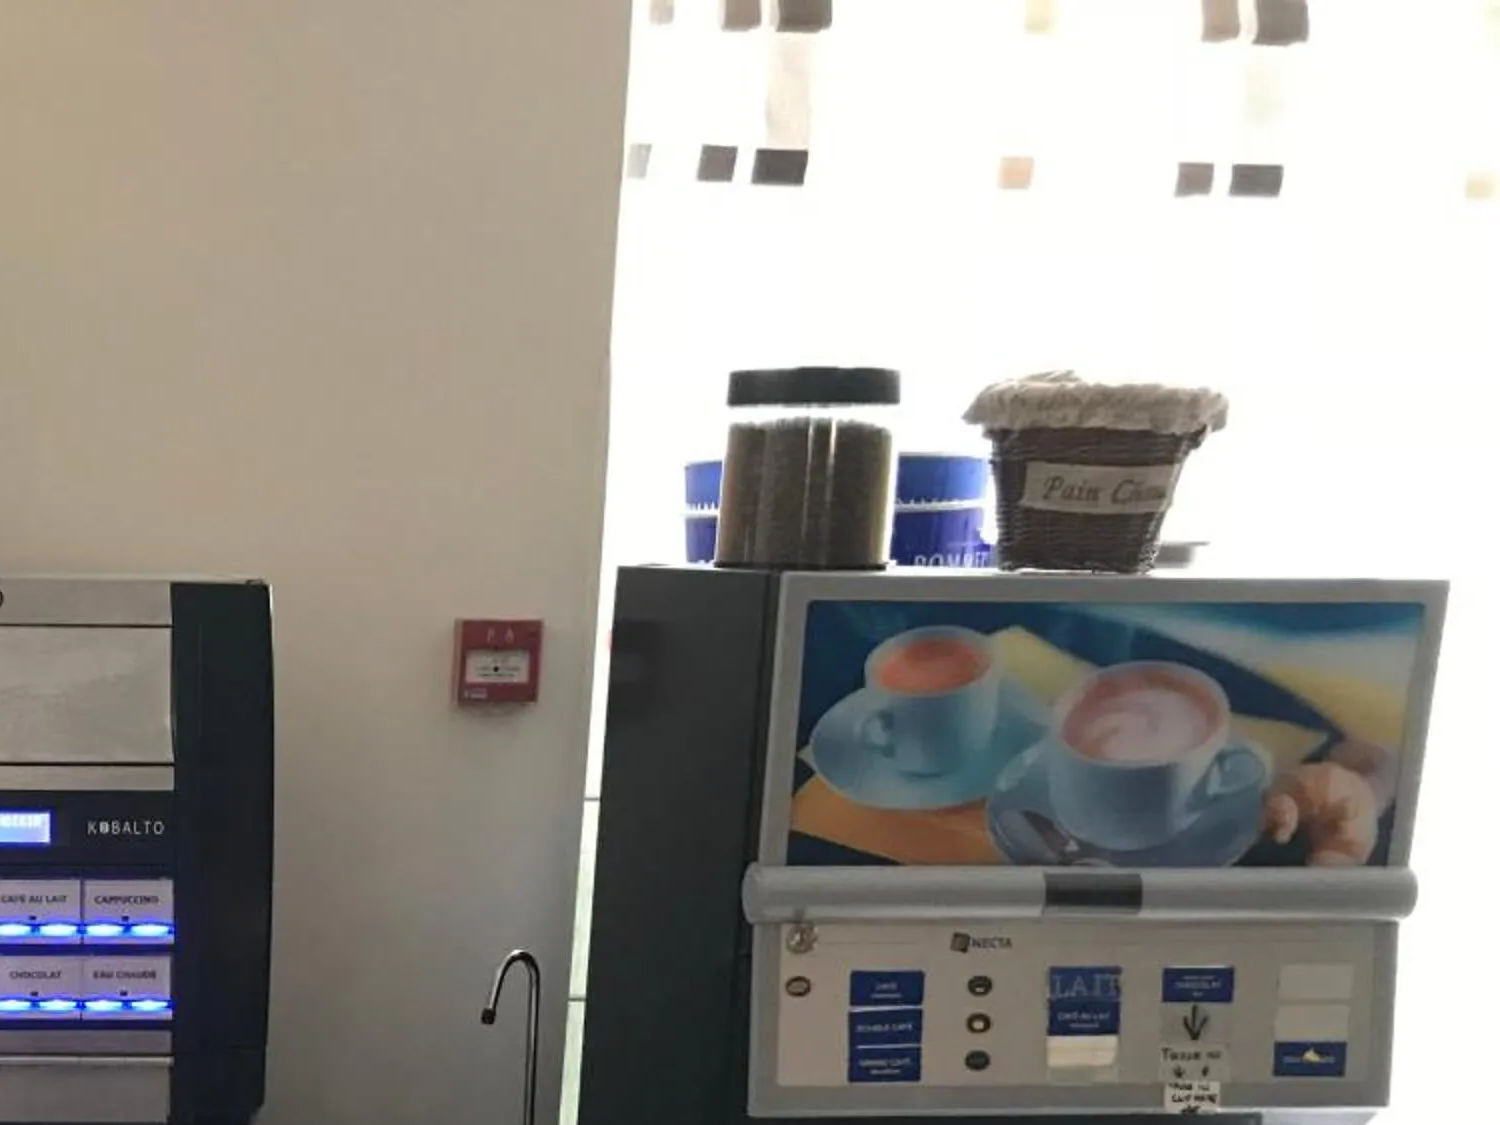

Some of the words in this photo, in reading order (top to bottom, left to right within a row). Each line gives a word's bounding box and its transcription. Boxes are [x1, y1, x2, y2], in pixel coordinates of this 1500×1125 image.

[1043, 475, 1100, 501] Pain
[87, 821, 165, 834] KOBALTO
[28, 895, 43, 903] AU
[45, 895, 67, 903] LAIT
[94, 895, 159, 904] CAPPUCCINO
[971, 937, 1013, 949] NECTA
[9, 970, 62, 979] CHOCOLAT
[93, 970, 114, 979] EAU
